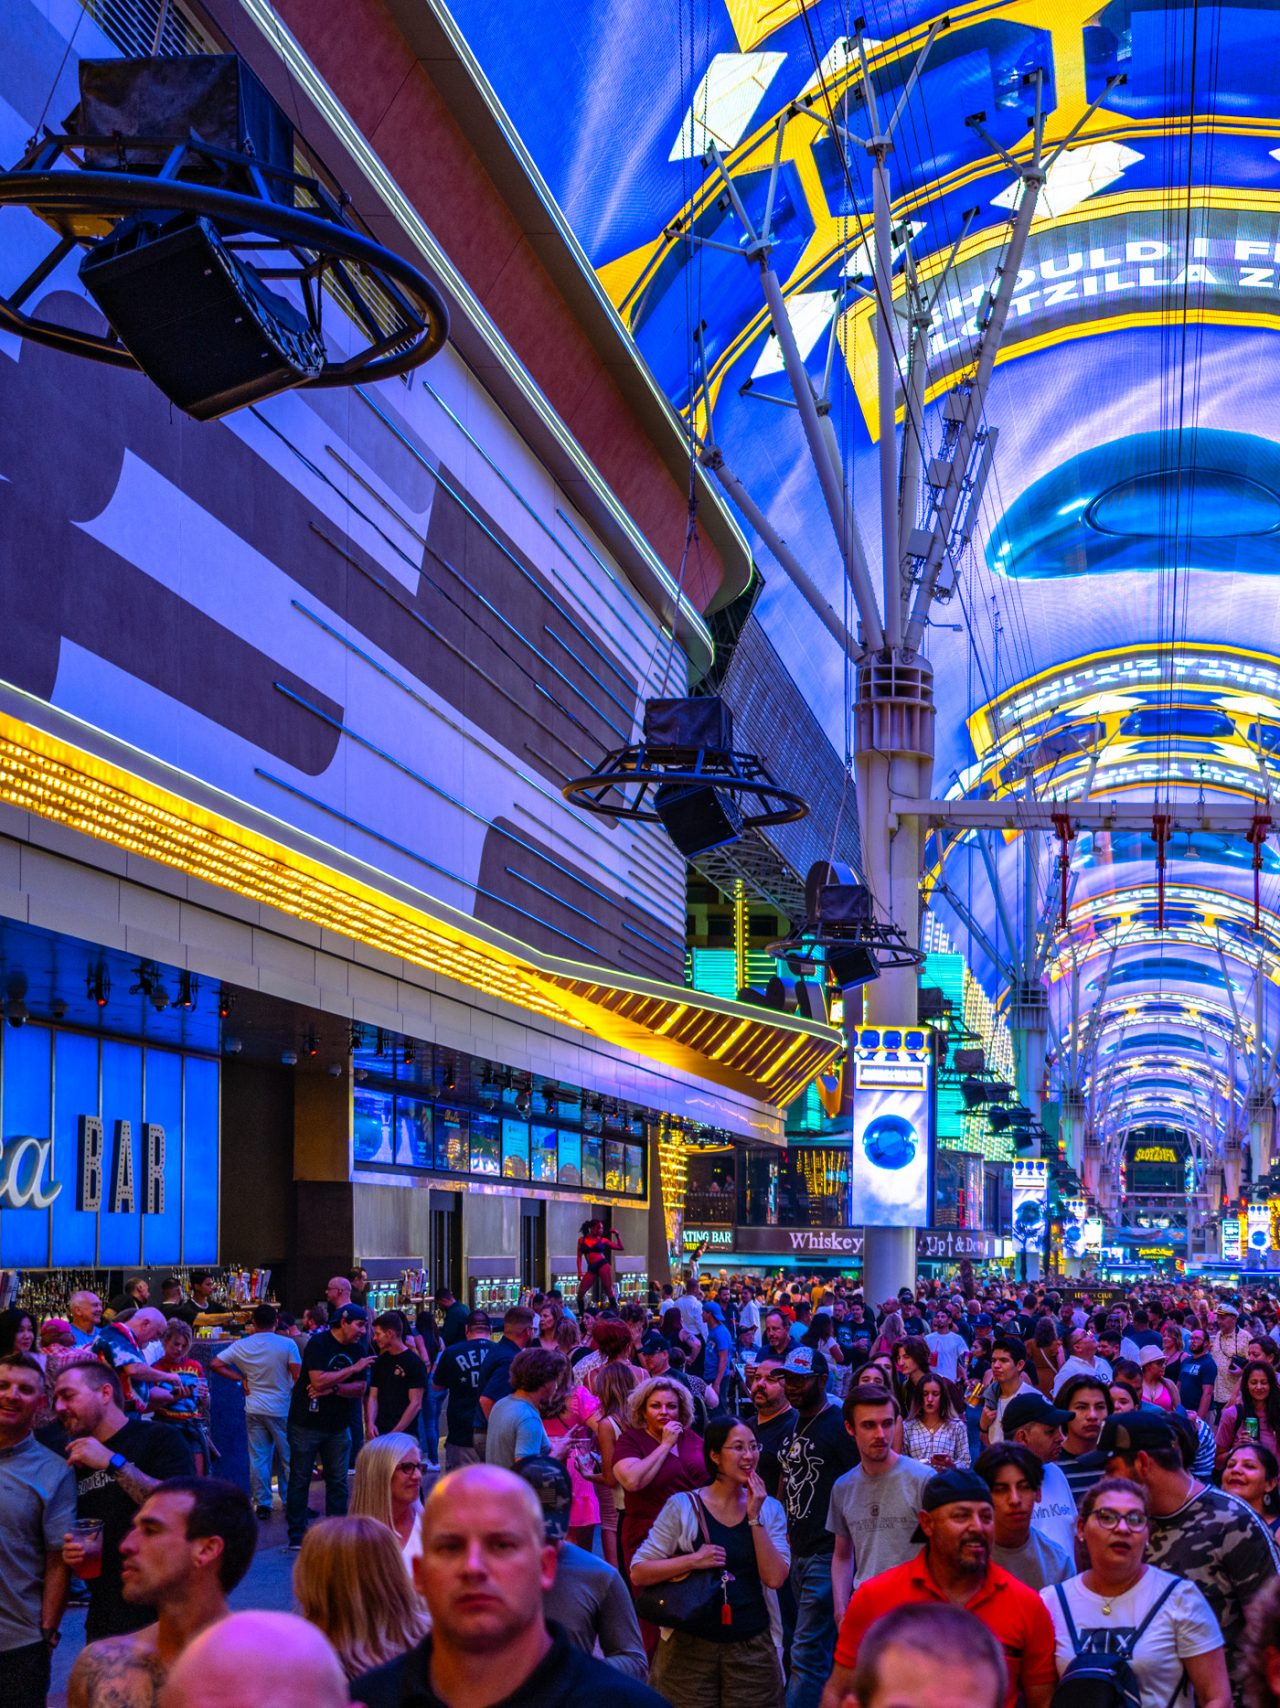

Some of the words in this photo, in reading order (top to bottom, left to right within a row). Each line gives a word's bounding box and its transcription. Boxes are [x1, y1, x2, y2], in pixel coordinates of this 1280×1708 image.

[1193, 237, 1209, 258] I
[78, 1115, 166, 1214] BAR
[711, 1231, 733, 1244] BAR
[789, 1231, 864, 1254] Whiskey
[955, 1236, 965, 1253] &
